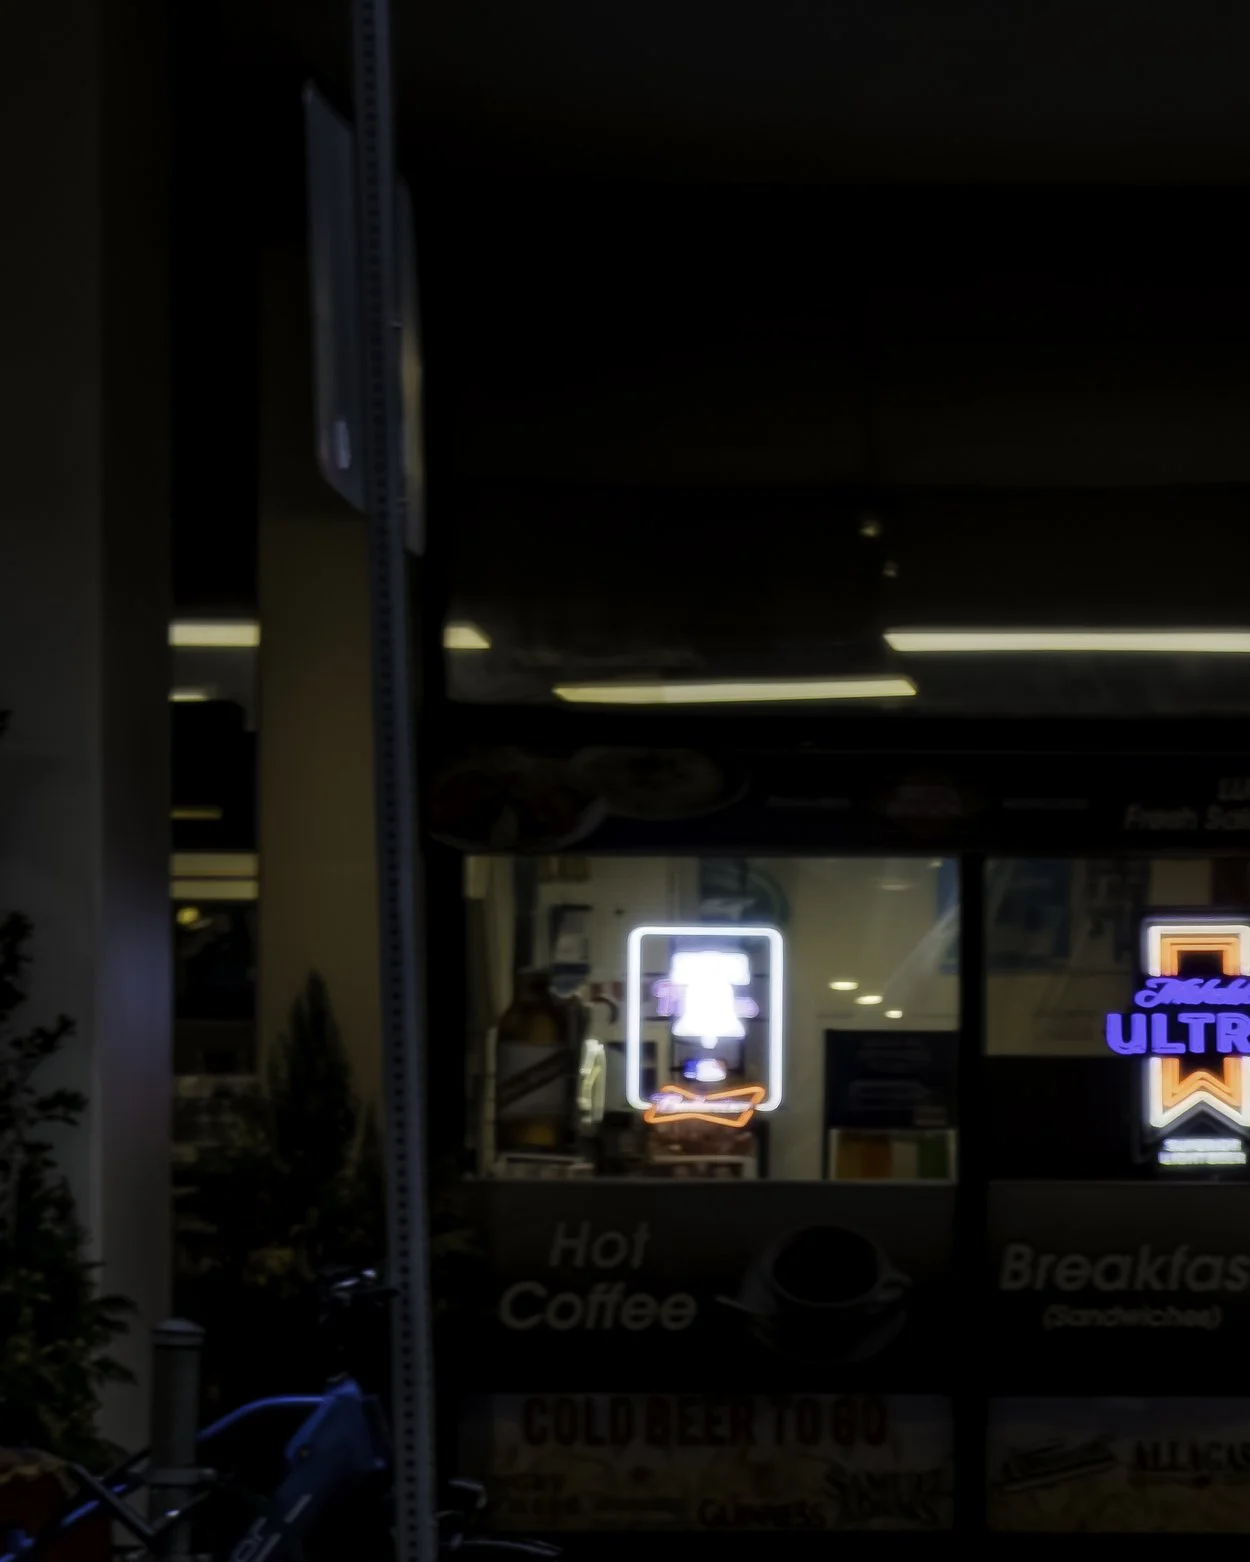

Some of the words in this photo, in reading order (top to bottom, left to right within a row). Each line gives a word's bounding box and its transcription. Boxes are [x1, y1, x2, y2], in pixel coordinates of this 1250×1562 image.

[549, 1221, 650, 1269] Hot
[498, 1279, 700, 1332] Coffee
[523, 1396, 634, 1446] COLD
[645, 1396, 755, 1446] BEER
[770, 1396, 821, 1446] TO
[832, 1396, 888, 1446] GO
